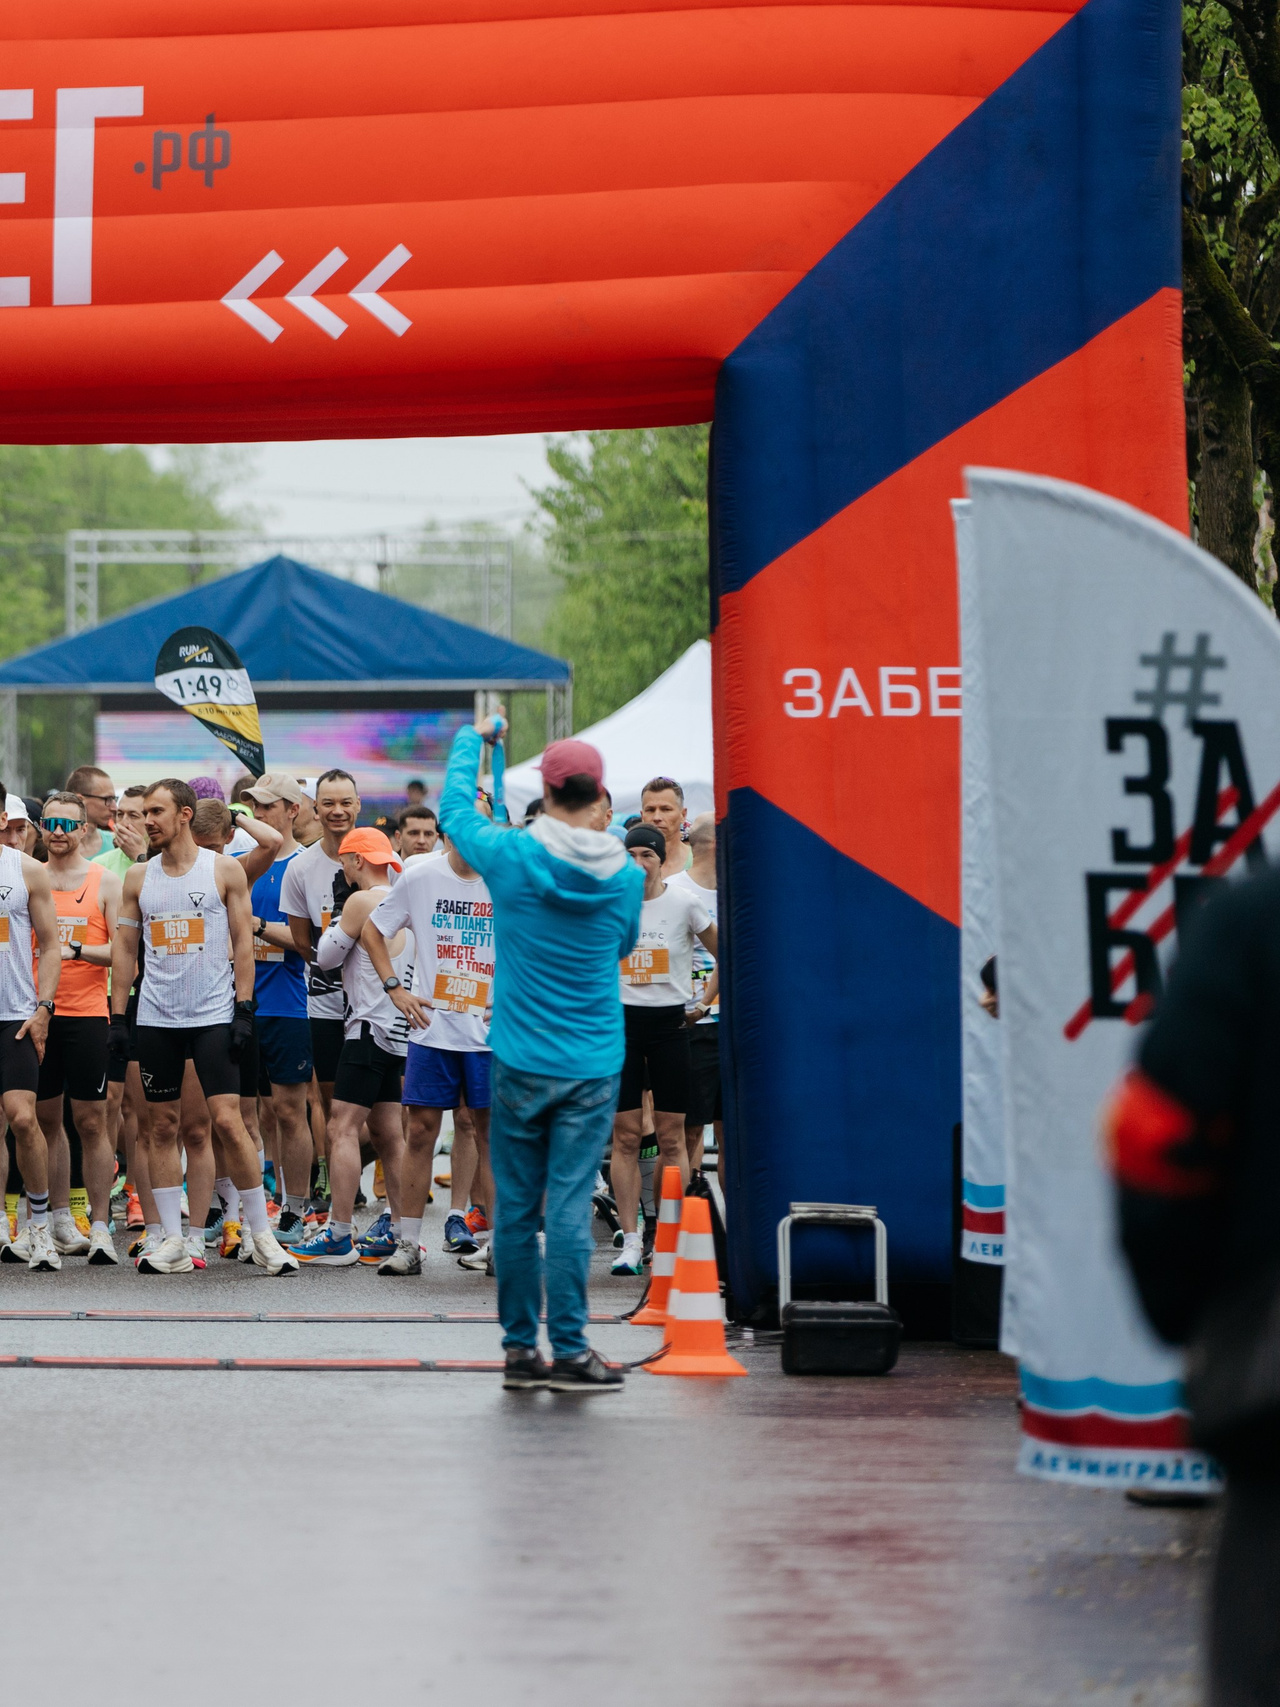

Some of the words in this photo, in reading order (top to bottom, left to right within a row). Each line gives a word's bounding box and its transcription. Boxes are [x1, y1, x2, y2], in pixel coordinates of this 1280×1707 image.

[179, 644, 199, 657] RUN
[195, 652, 214, 663] LAB
[173, 675, 222, 699] 1:49
[163, 920, 189, 939] 1619
[431, 914, 452, 929] 45%
[461, 931, 492, 948] БЕГУТ
[436, 944, 476, 960] ВМЕСТЕ
[628, 950, 654, 968] 1715
[444, 977, 478, 999] 2090
